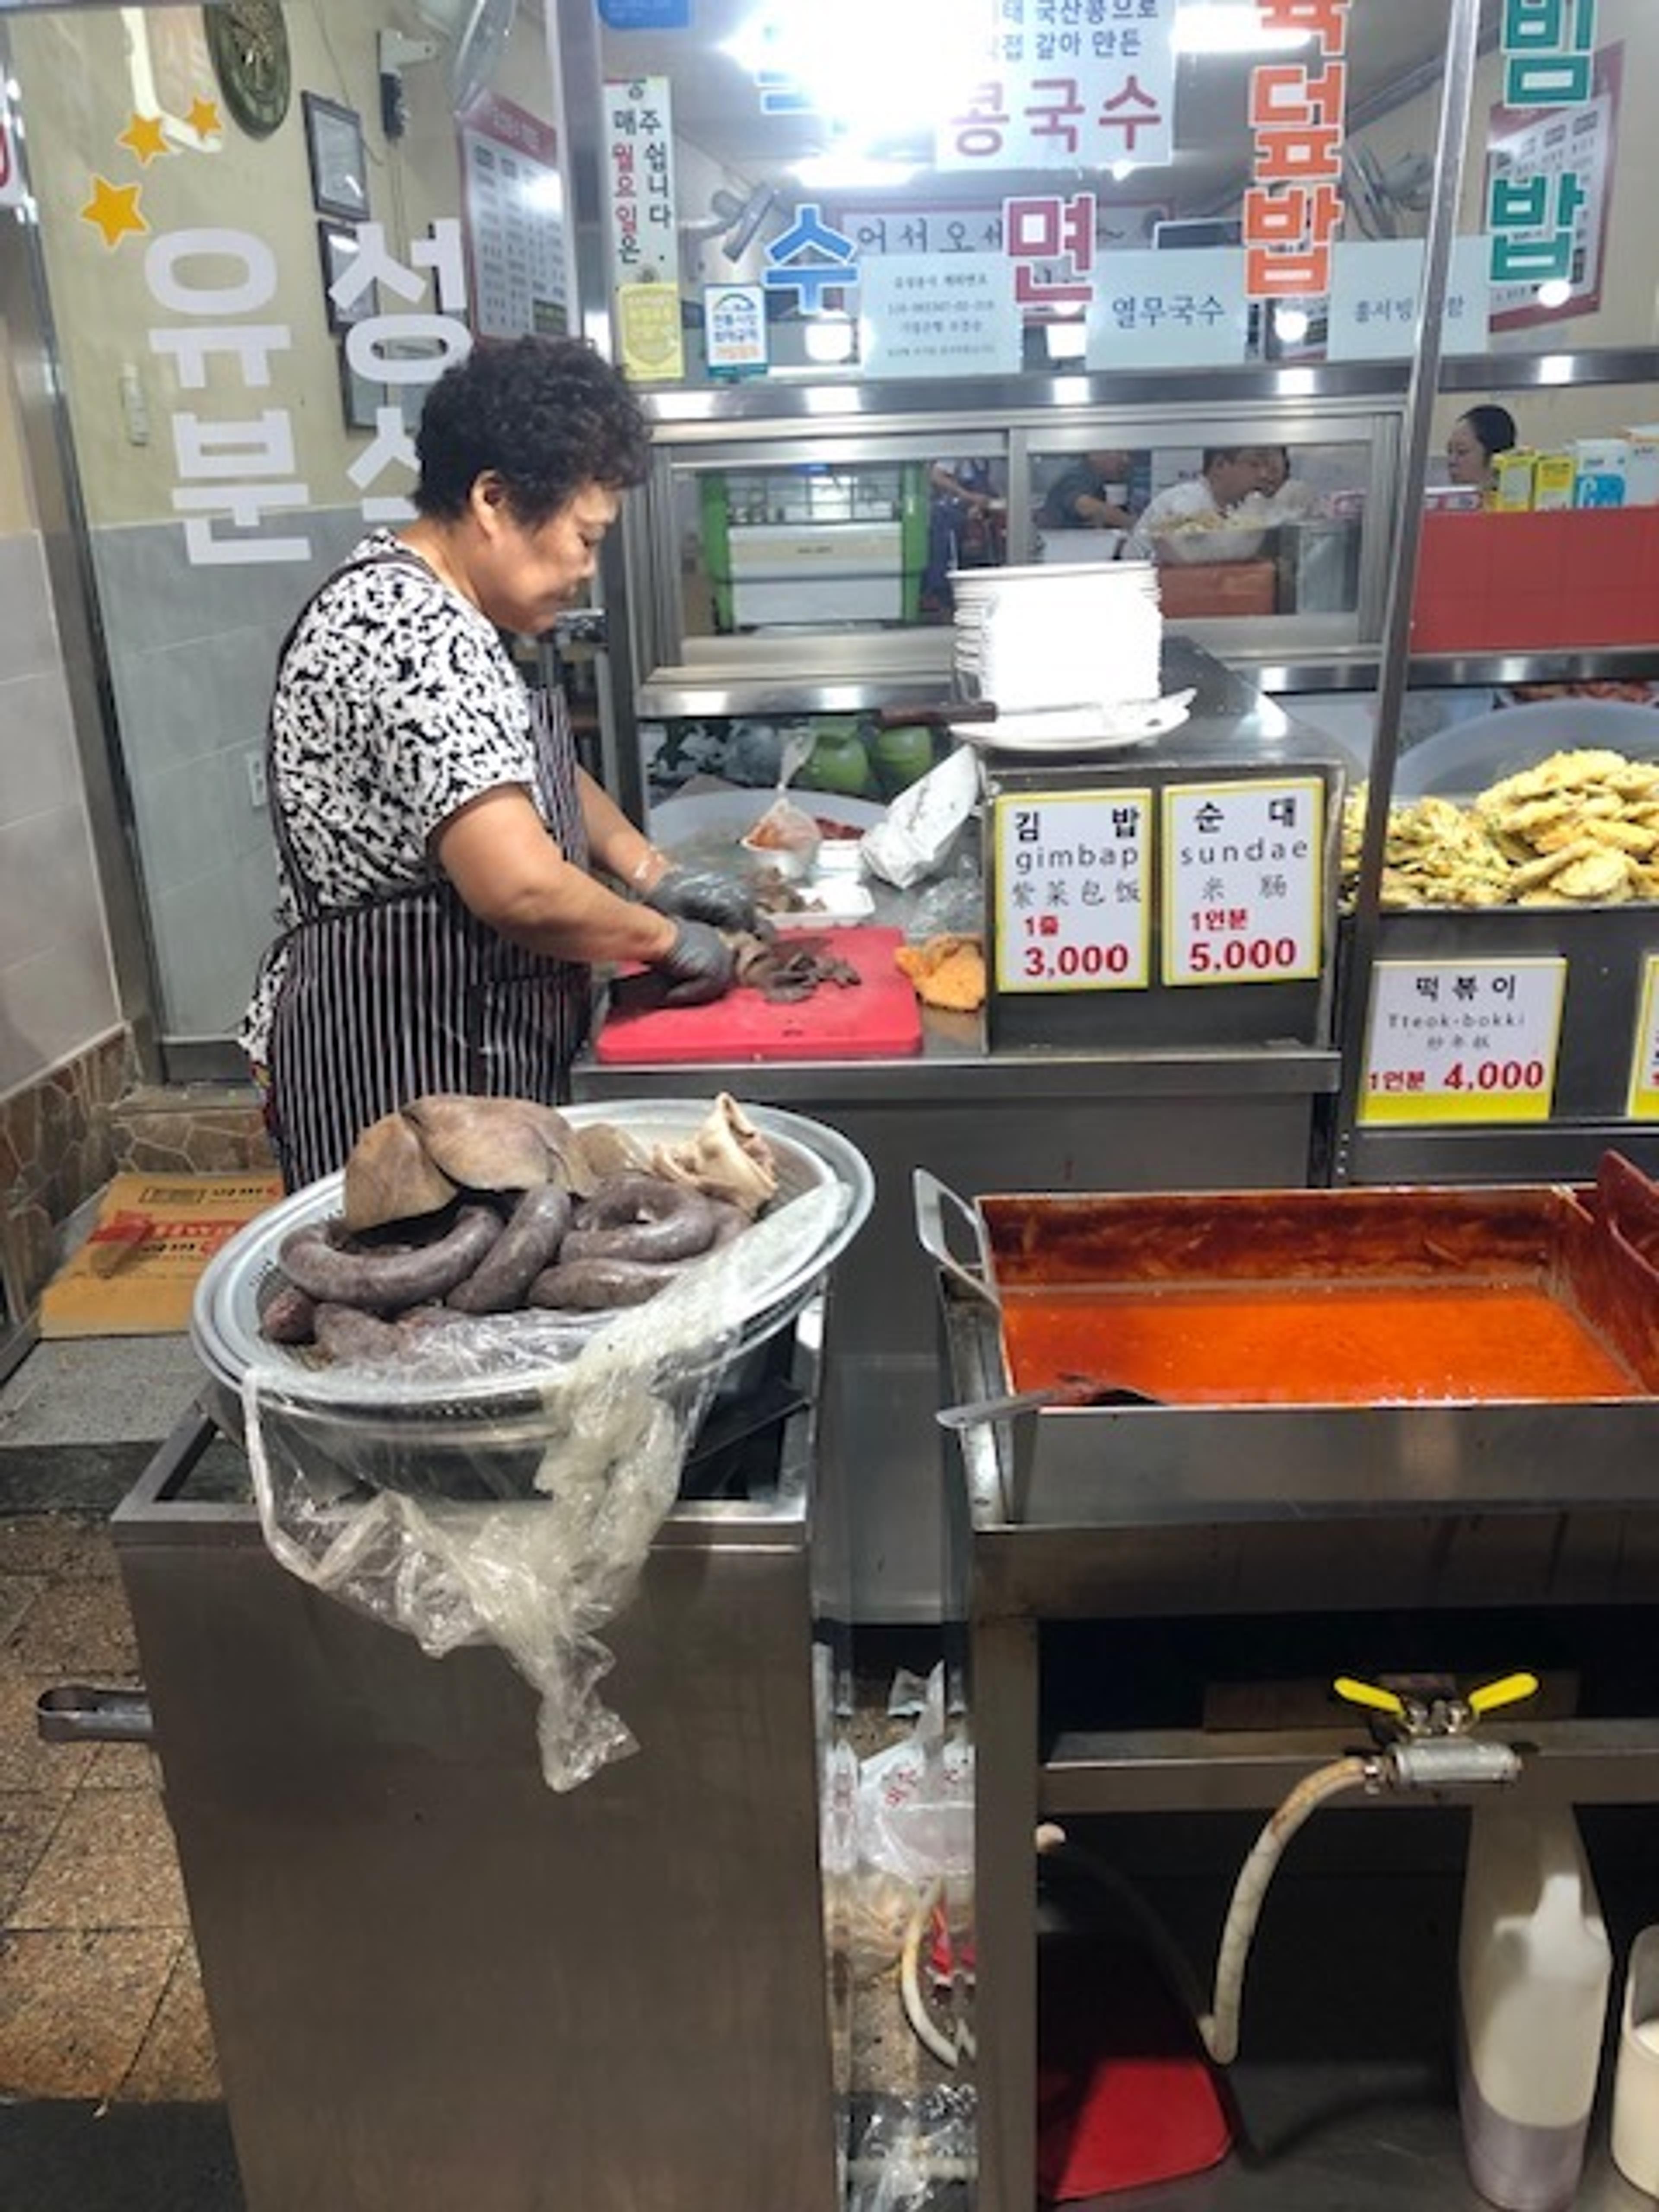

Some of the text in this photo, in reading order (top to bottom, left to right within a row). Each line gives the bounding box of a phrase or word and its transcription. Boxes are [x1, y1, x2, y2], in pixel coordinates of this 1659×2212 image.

[1091, 29, 1142, 59] 만든
[953, 75, 1161, 157] 콩국수
[611, 142, 640, 264] 일요일은
[1112, 295, 1225, 329] 열무국수
[1016, 843, 1138, 875] gimbap
[1181, 837, 1308, 865] sundae
[1191, 909, 1246, 931] 1인분
[1025, 944, 1128, 977] 3,000
[1191, 938, 1296, 972] 5,000
[1417, 975, 1516, 1001] 떡볶이
[1370, 1061, 1544, 1090] 1인분 4,000
